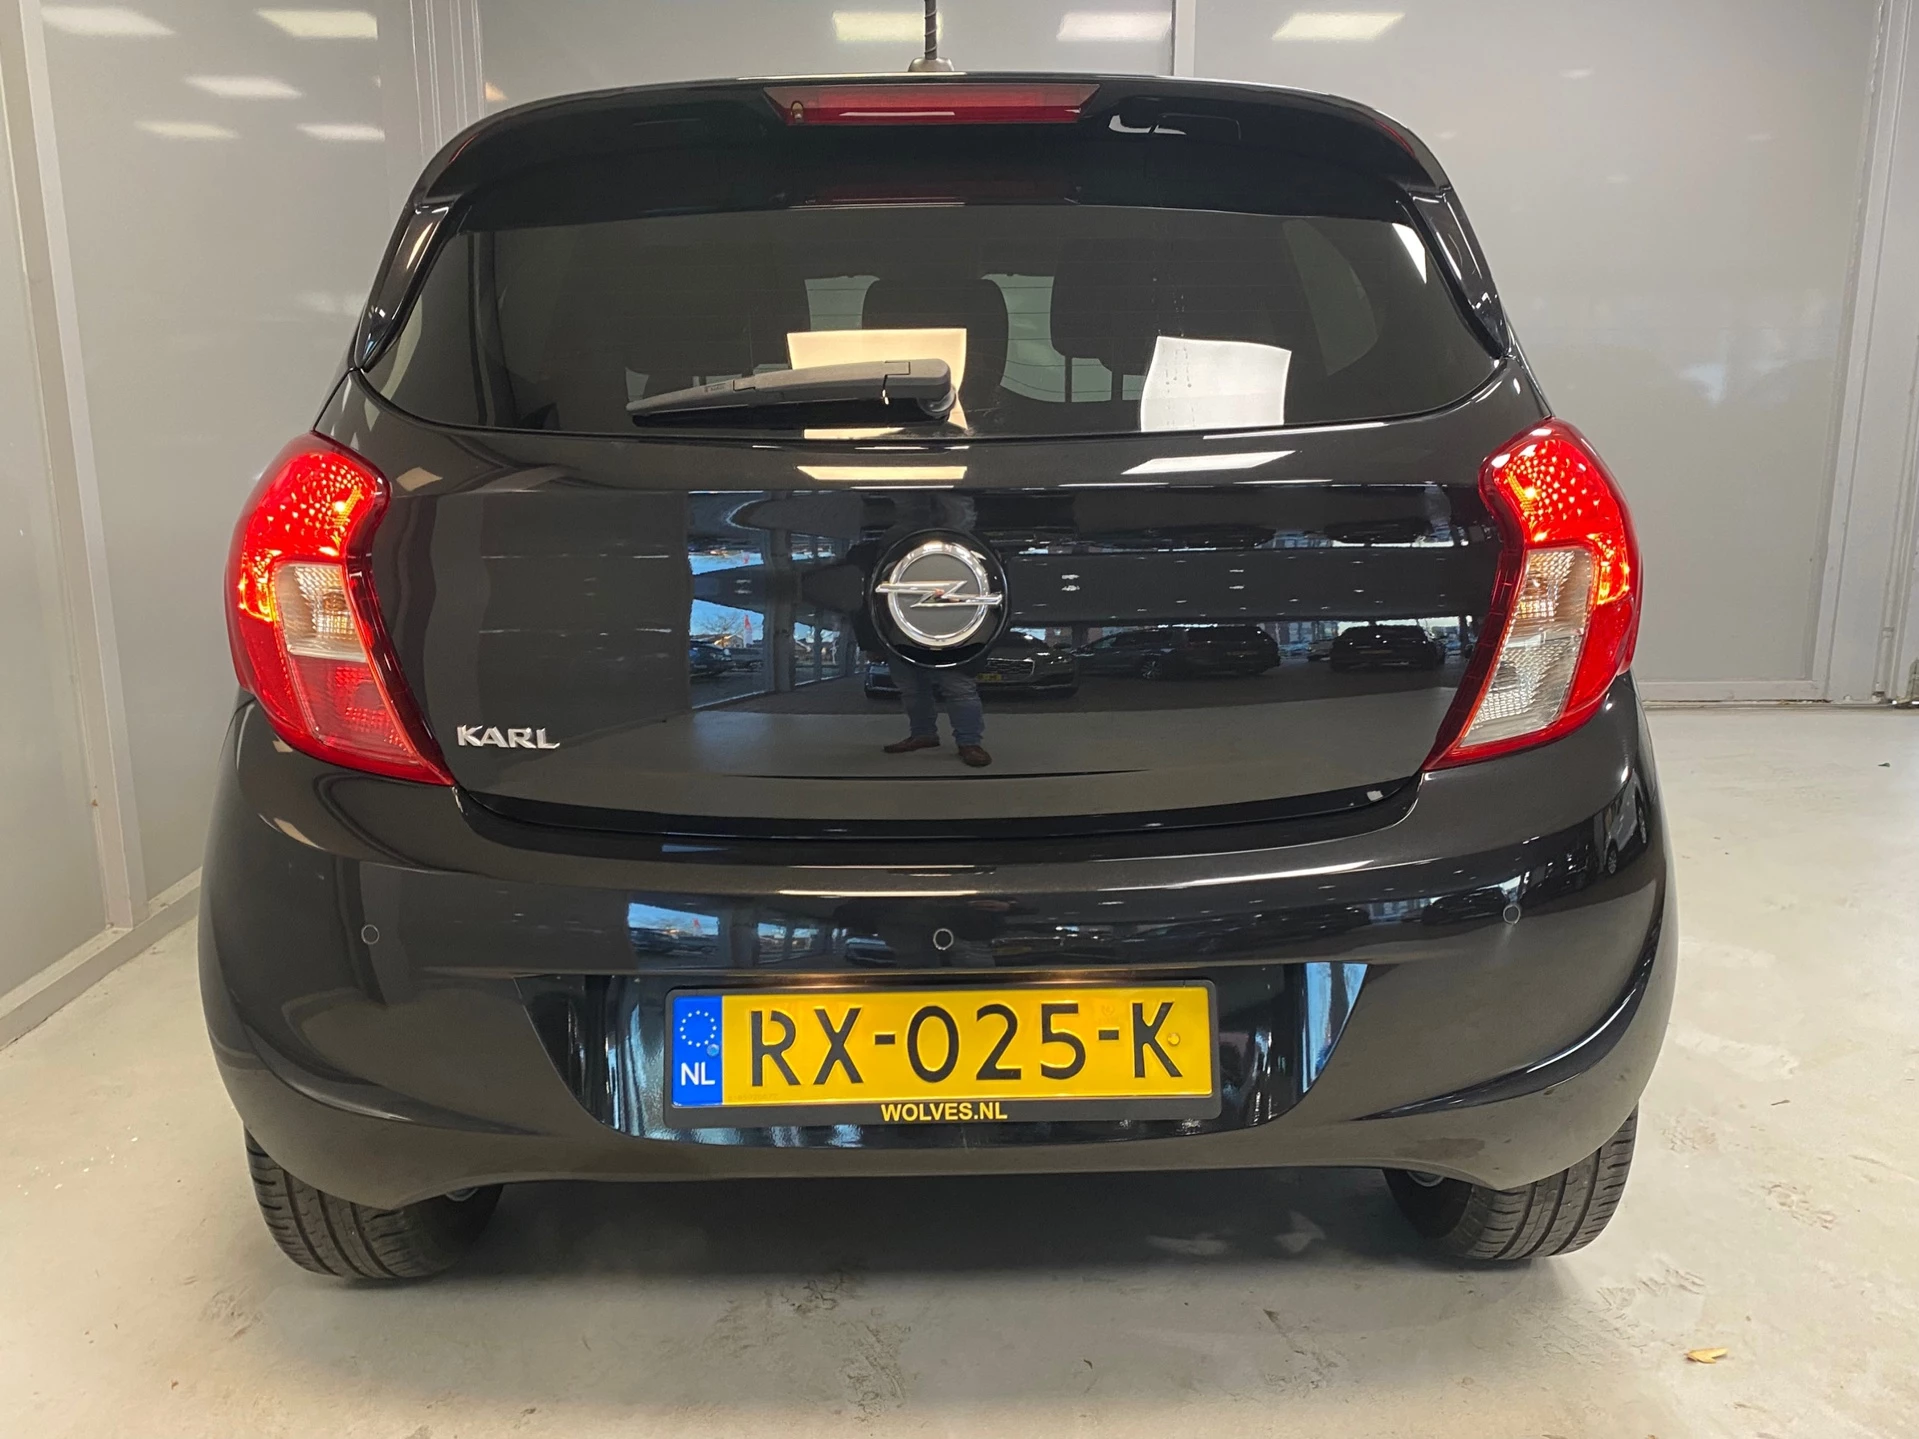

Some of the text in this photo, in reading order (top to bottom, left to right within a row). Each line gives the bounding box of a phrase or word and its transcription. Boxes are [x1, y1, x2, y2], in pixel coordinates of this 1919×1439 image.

[457, 724, 560, 749] KARL
[750, 1001, 1184, 1087] RX-025-K
[681, 1061, 716, 1086] NL
[880, 1102, 1008, 1122] WOLVES.NL
